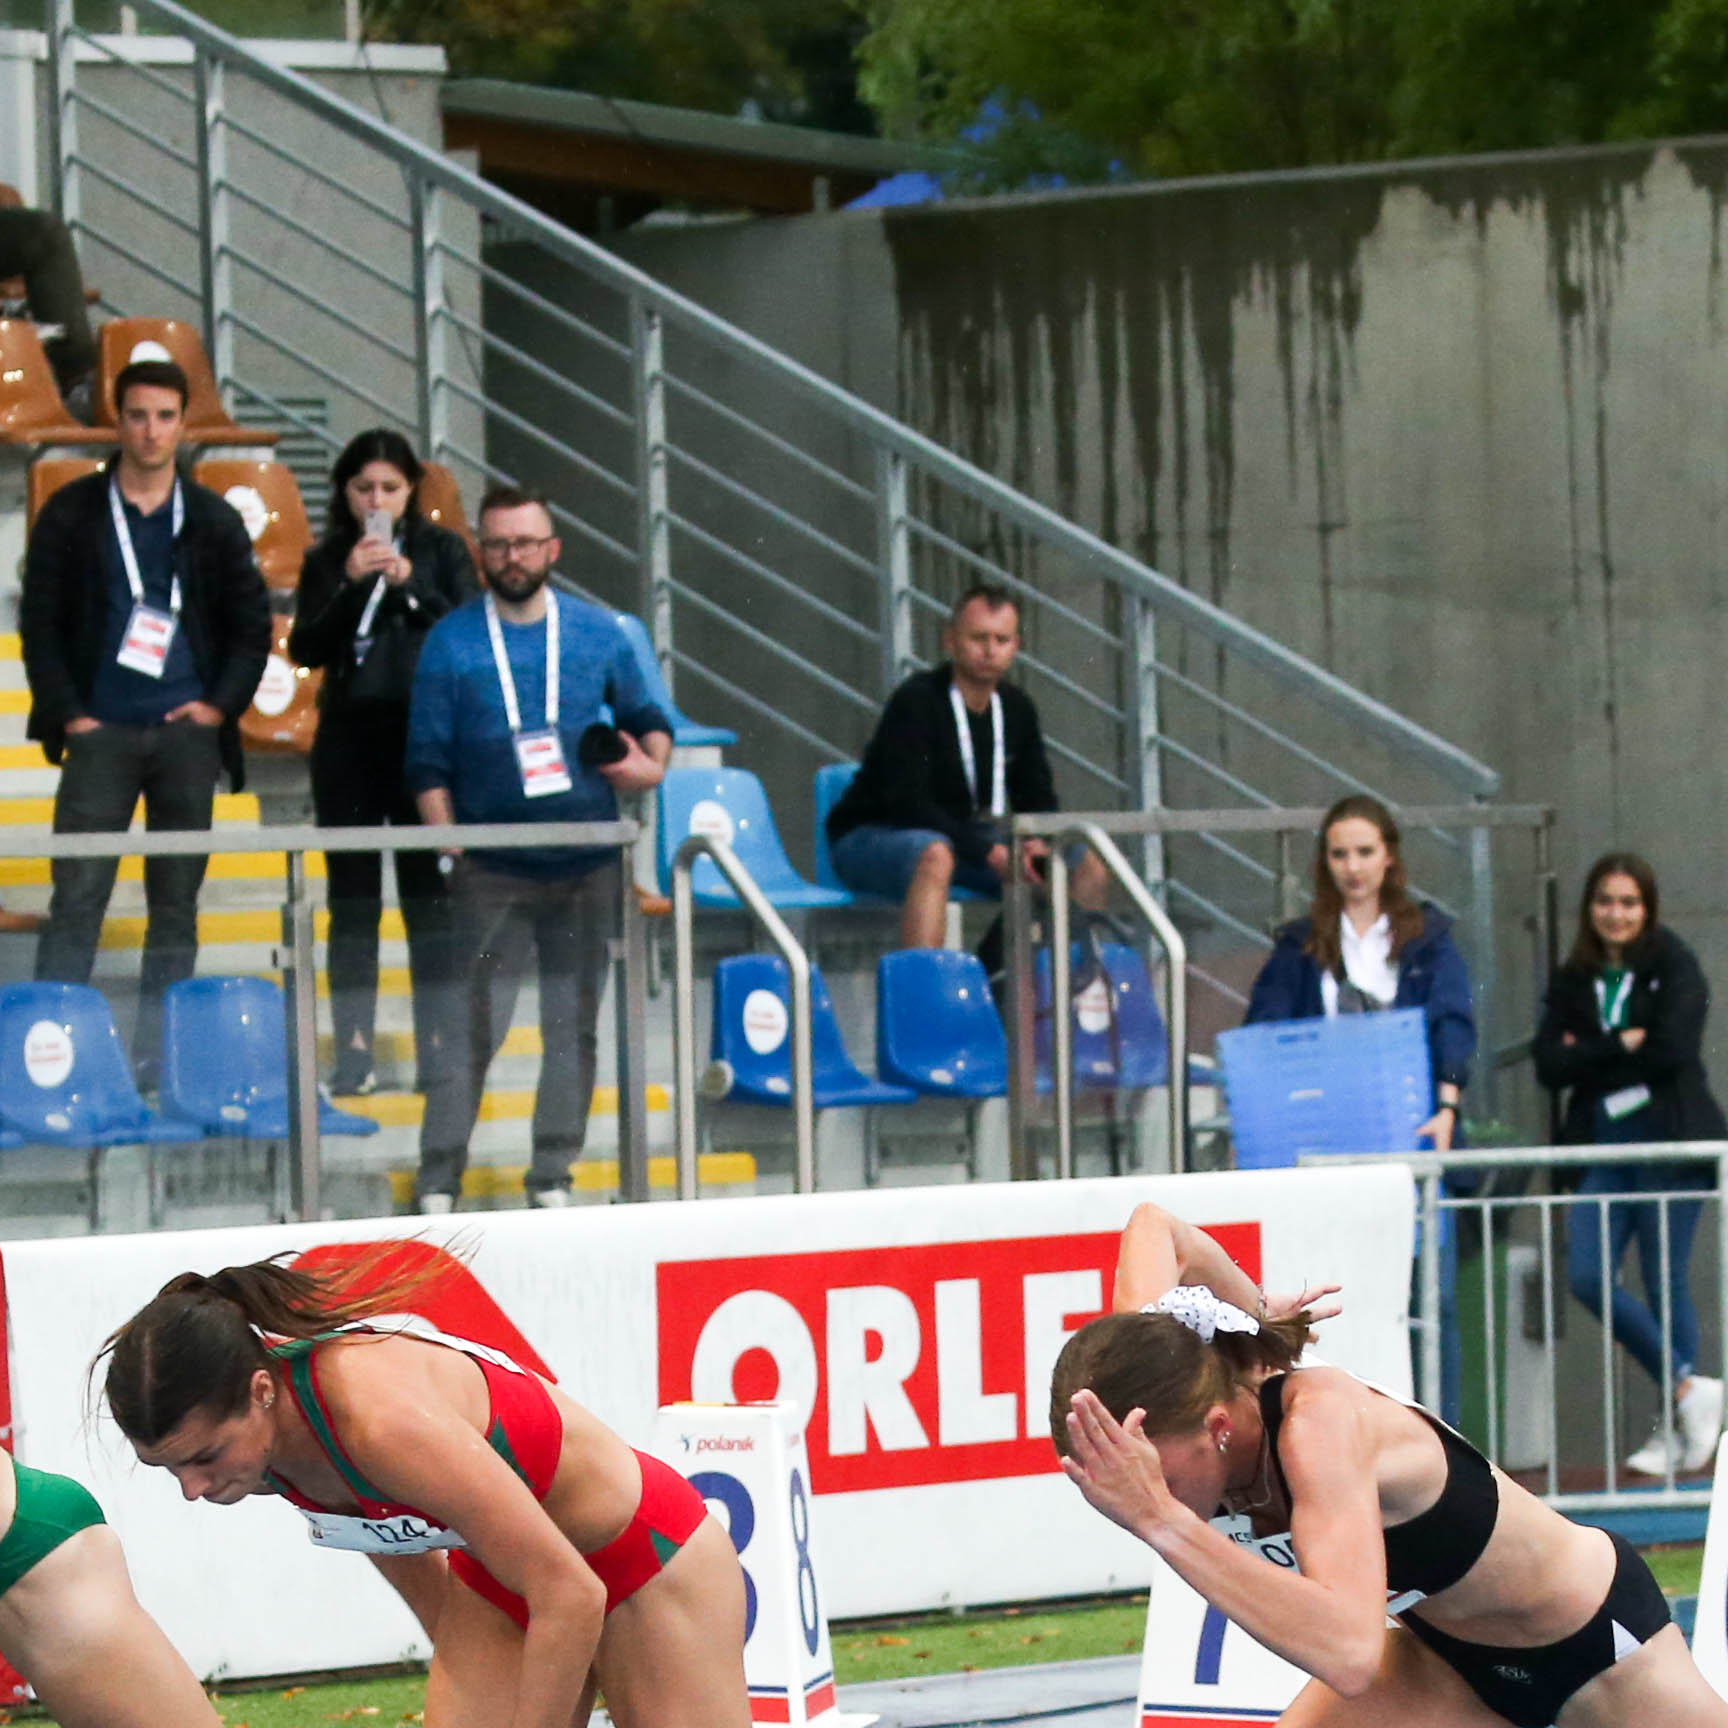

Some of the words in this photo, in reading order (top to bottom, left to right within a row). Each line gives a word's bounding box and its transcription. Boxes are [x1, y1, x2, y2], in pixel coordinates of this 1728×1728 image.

[691, 1269, 1103, 1456] ORLE
[696, 1435, 754, 1455] polanik
[790, 1467, 819, 1658] 8
